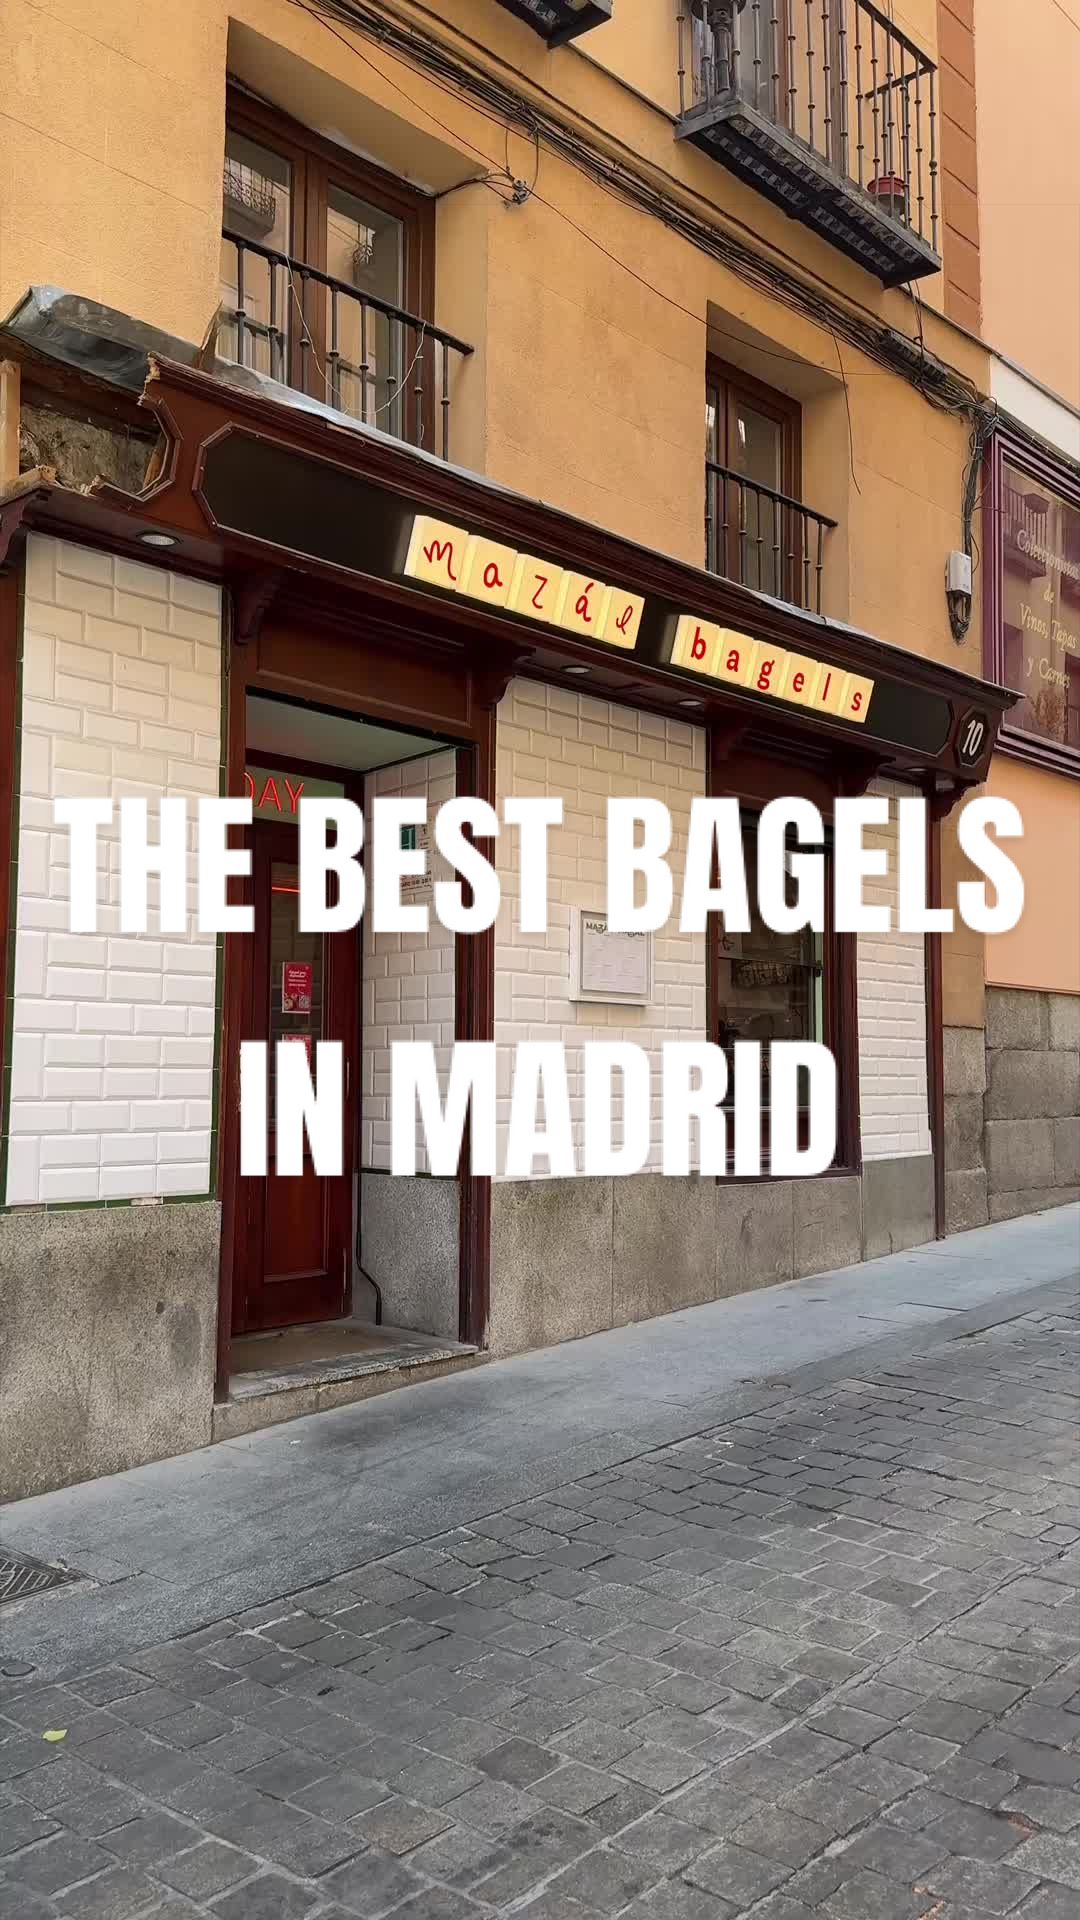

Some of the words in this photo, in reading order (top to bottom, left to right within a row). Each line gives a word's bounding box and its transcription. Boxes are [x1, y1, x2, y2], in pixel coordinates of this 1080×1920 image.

[1043, 582, 1056, 605] de
[1050, 619, 1077, 652] Tapas
[689, 626, 864, 712] bagels
[1025, 656, 1035, 678] y
[1038, 657, 1072, 689] Carnes
[961, 718, 985, 757] 10
